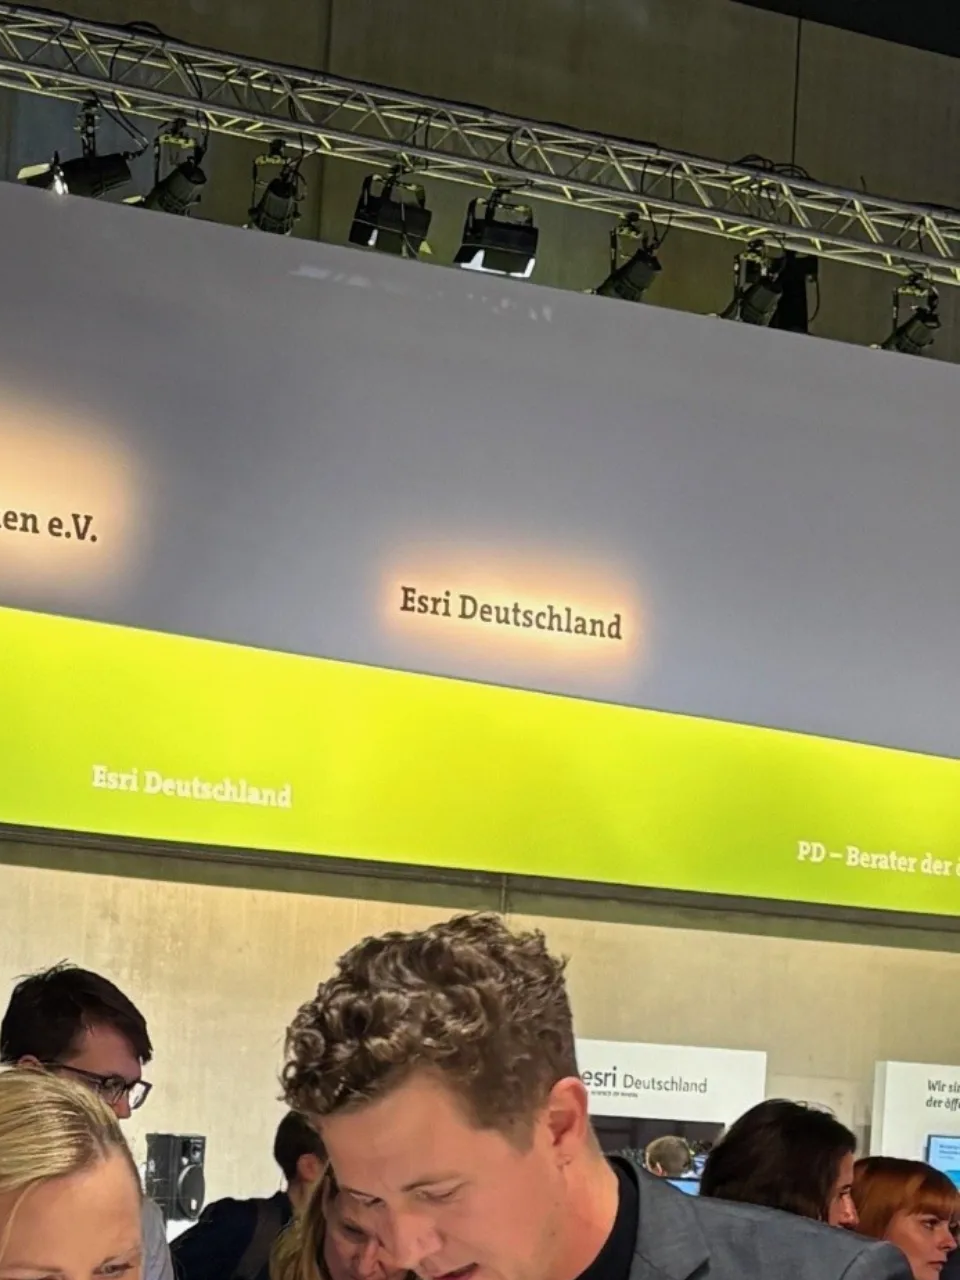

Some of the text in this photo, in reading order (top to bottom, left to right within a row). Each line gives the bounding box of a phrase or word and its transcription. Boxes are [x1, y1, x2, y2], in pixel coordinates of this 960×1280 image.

[47, 513, 98, 543] e.V.
[400, 586, 622, 640] Esri Deutschland
[92, 765, 292, 808] Esri Deutschland
[797, 840, 826, 862] PD
[846, 846, 917, 872] Berater
[921, 852, 953, 876] der
[581, 1065, 708, 1094] esri Deutschland
[927, 1079, 946, 1092] Wir
[925, 1095, 944, 1108] der
